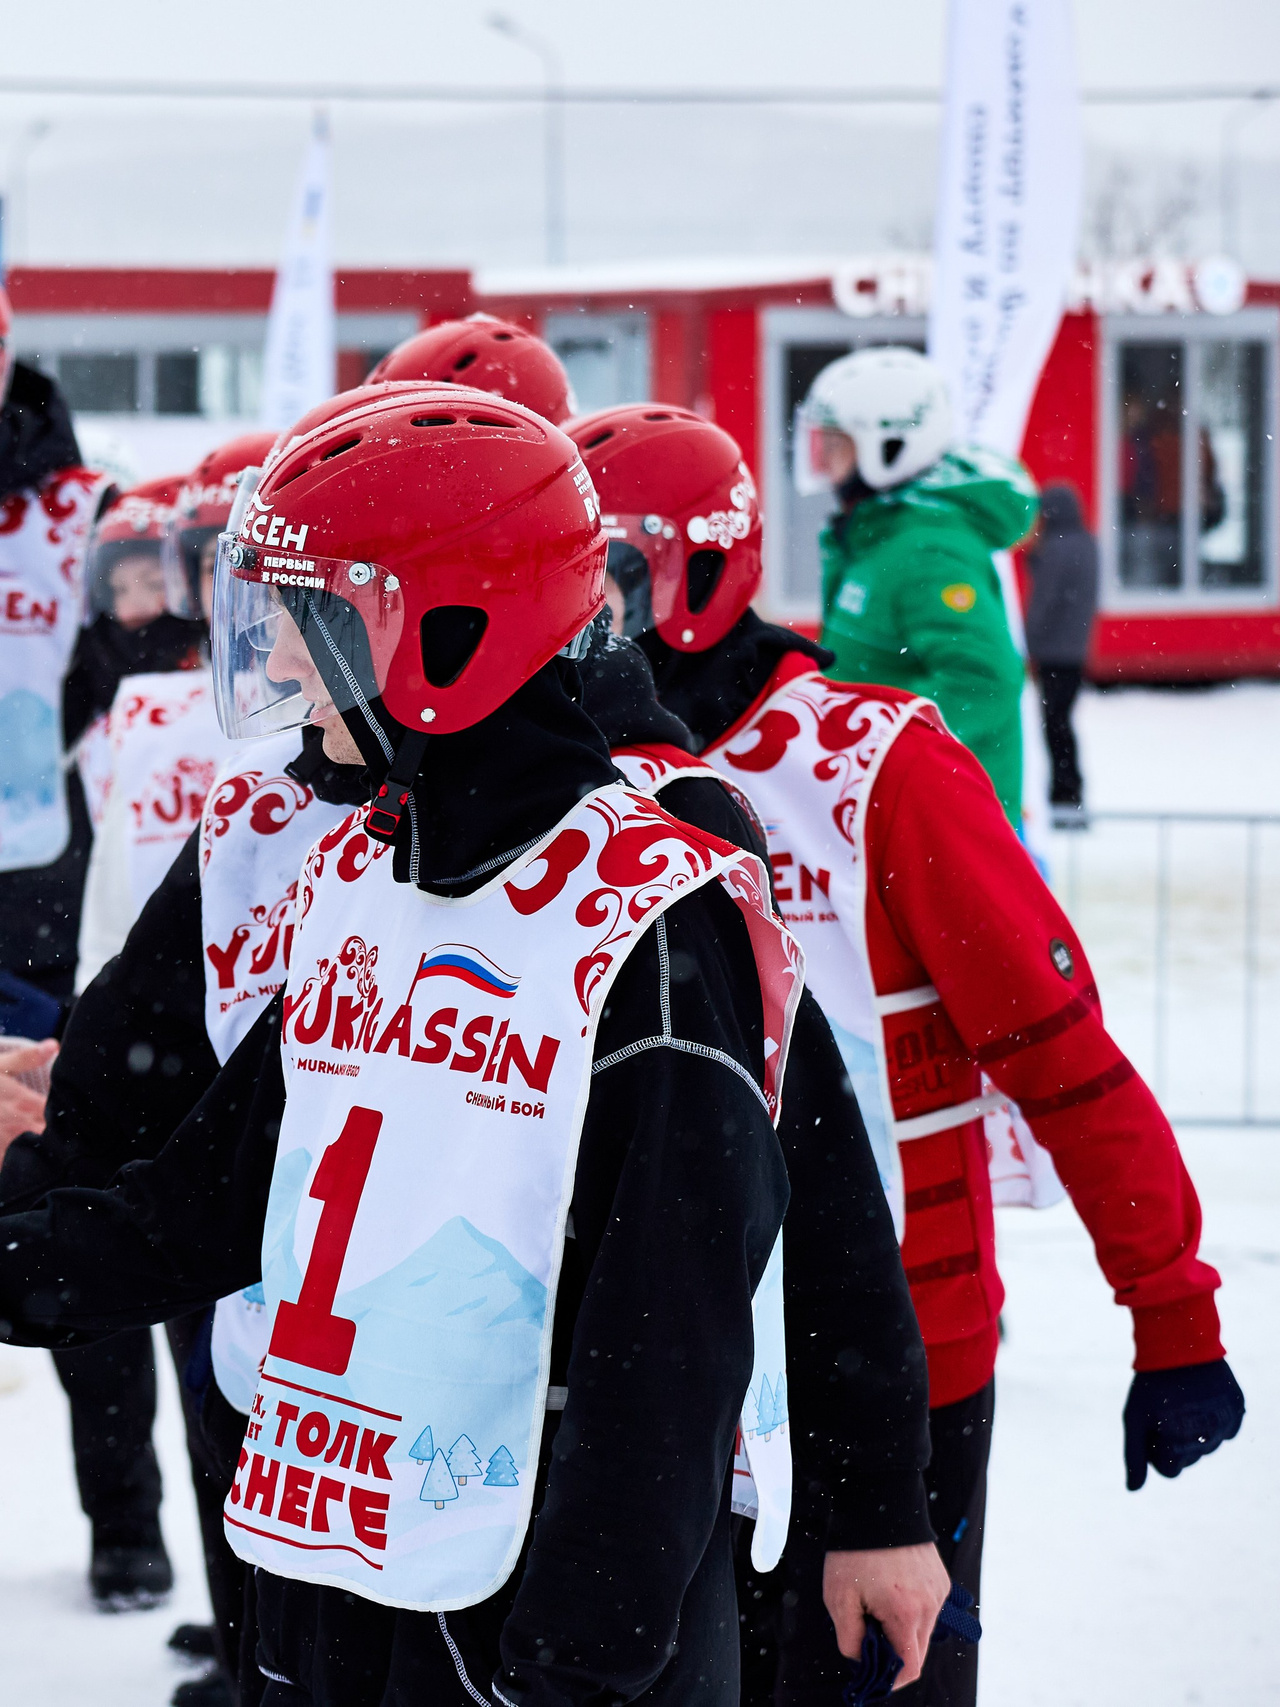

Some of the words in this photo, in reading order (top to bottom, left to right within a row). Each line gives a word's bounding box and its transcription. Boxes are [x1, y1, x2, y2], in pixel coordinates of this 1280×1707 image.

[261, 571, 271, 582] В
[271, 573, 326, 589] РОССИИ
[263, 556, 315, 572] ПЕРВЫЕ
[510, 1101, 546, 1120] БОЙ
[268, 1105, 383, 1376] 1
[274, 1400, 398, 1481] ТОЛК
[230, 1446, 391, 1550] СНЕГЕ
